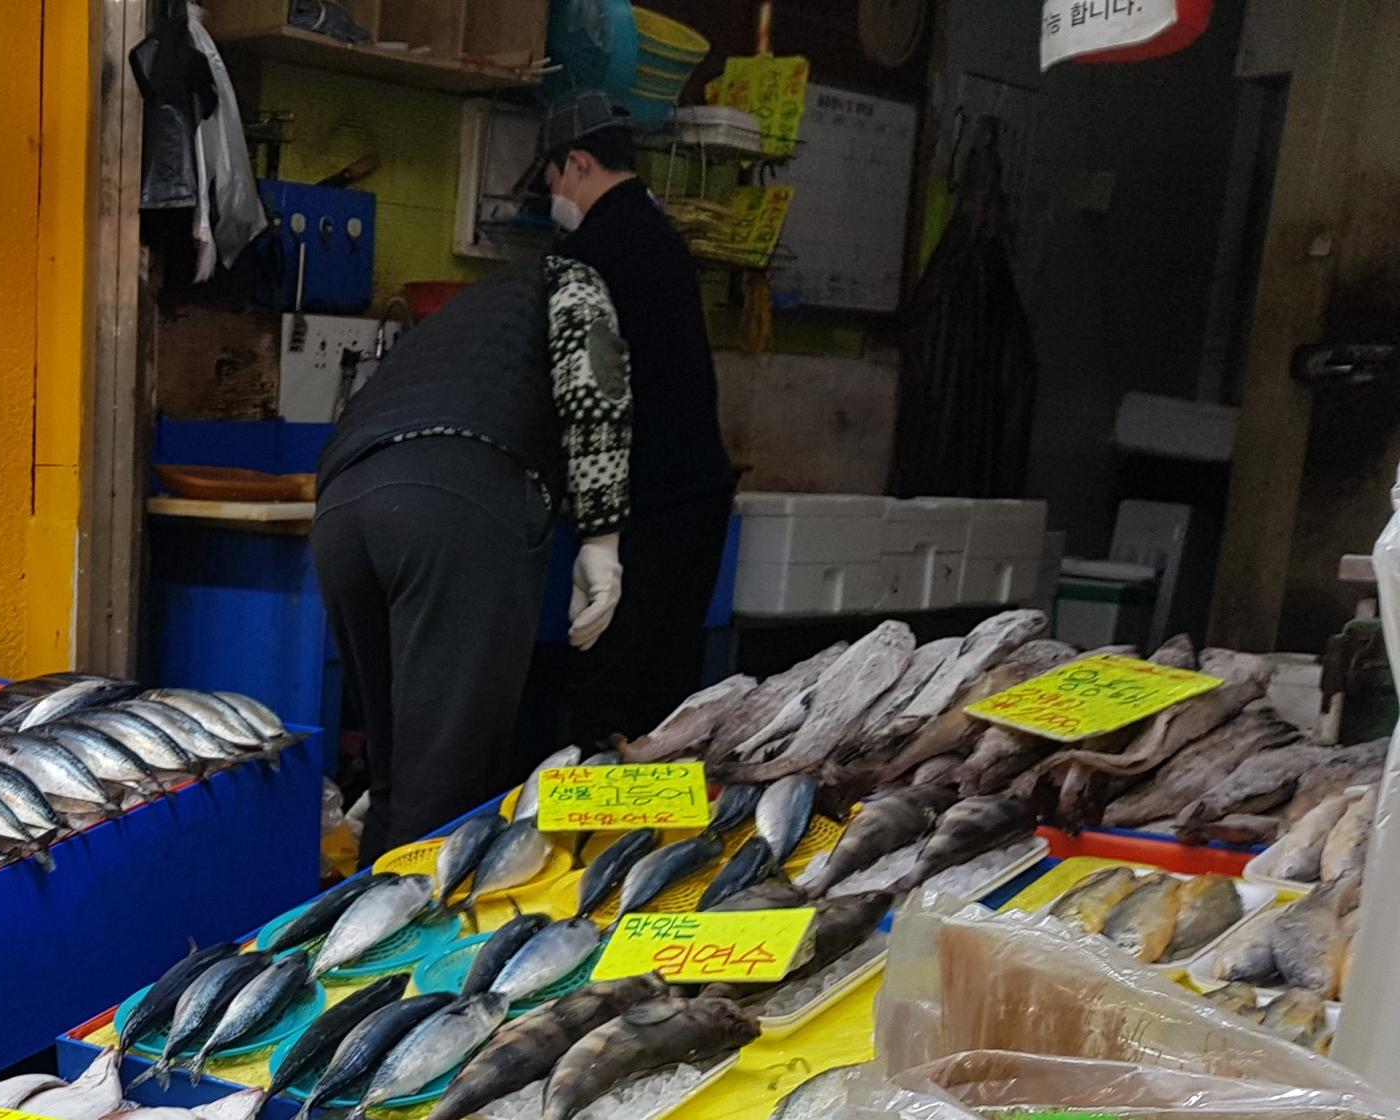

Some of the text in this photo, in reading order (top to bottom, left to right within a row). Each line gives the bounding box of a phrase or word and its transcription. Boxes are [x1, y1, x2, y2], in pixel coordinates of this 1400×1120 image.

[542, 766, 690, 784] 국산 (부산)
[549, 783, 695, 808] 생물 고등어
[624, 915, 701, 940] 맛있는
[651, 940, 777, 976] 임연수
